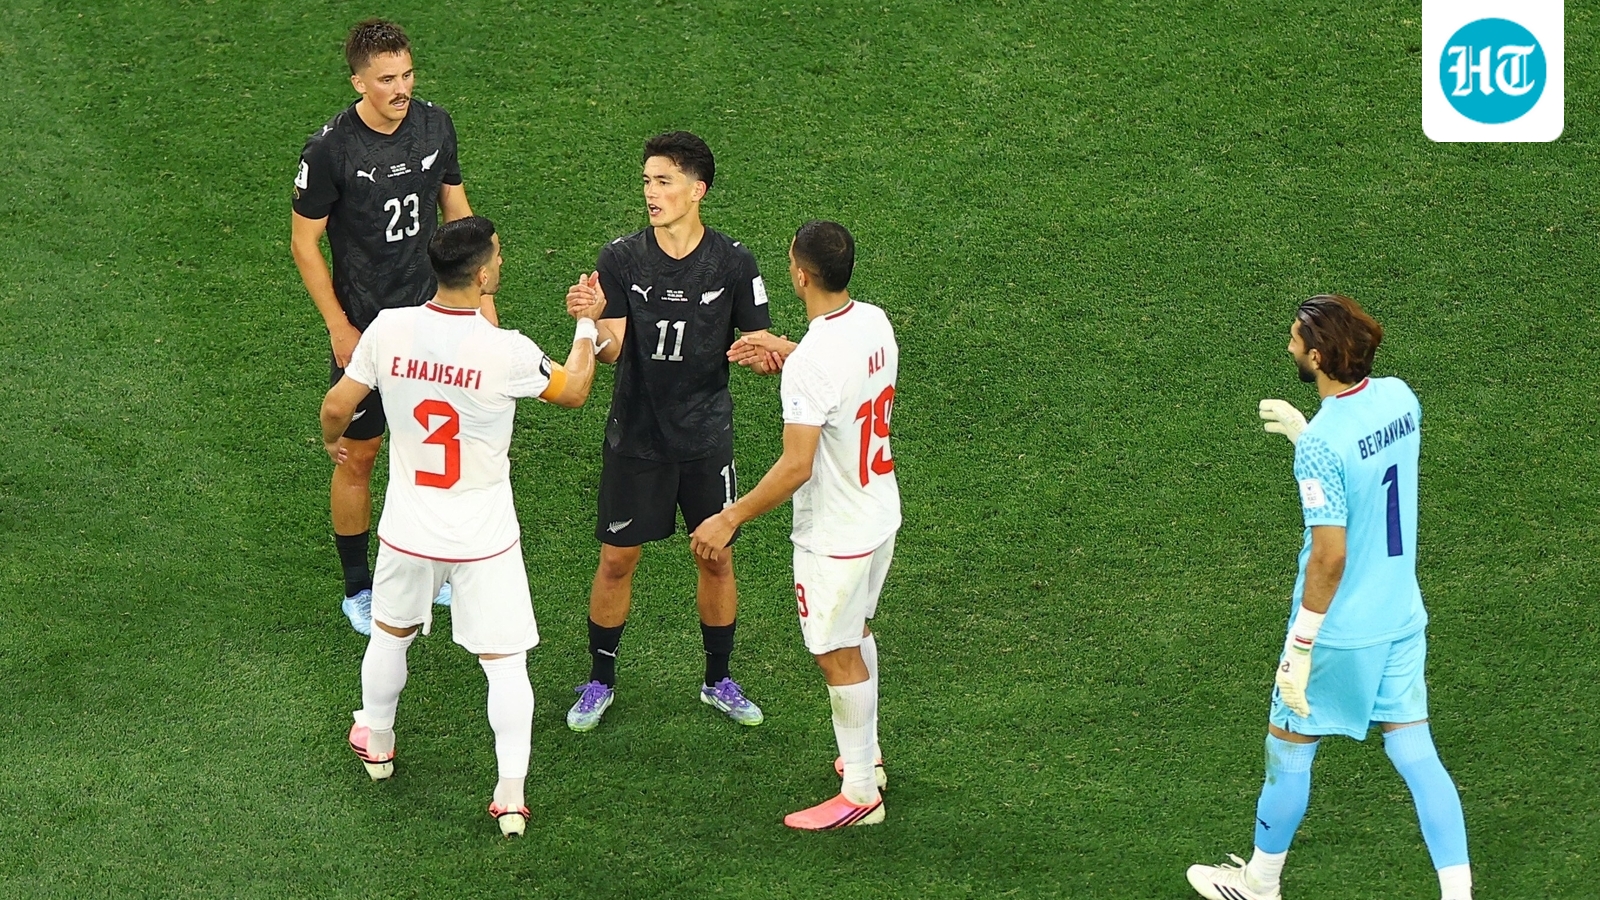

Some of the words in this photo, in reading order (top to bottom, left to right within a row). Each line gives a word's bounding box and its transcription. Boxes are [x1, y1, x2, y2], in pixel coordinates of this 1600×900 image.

[383, 192, 420, 243] 23
[651, 320, 687, 362] 11
[868, 346, 885, 378] ALI
[391, 356, 482, 390] E.HAJISAFI
[413, 399, 461, 489] 3
[853, 383, 896, 489] 19
[1357, 411, 1416, 461] BEIRANVAND
[1381, 463, 1404, 558] 1
